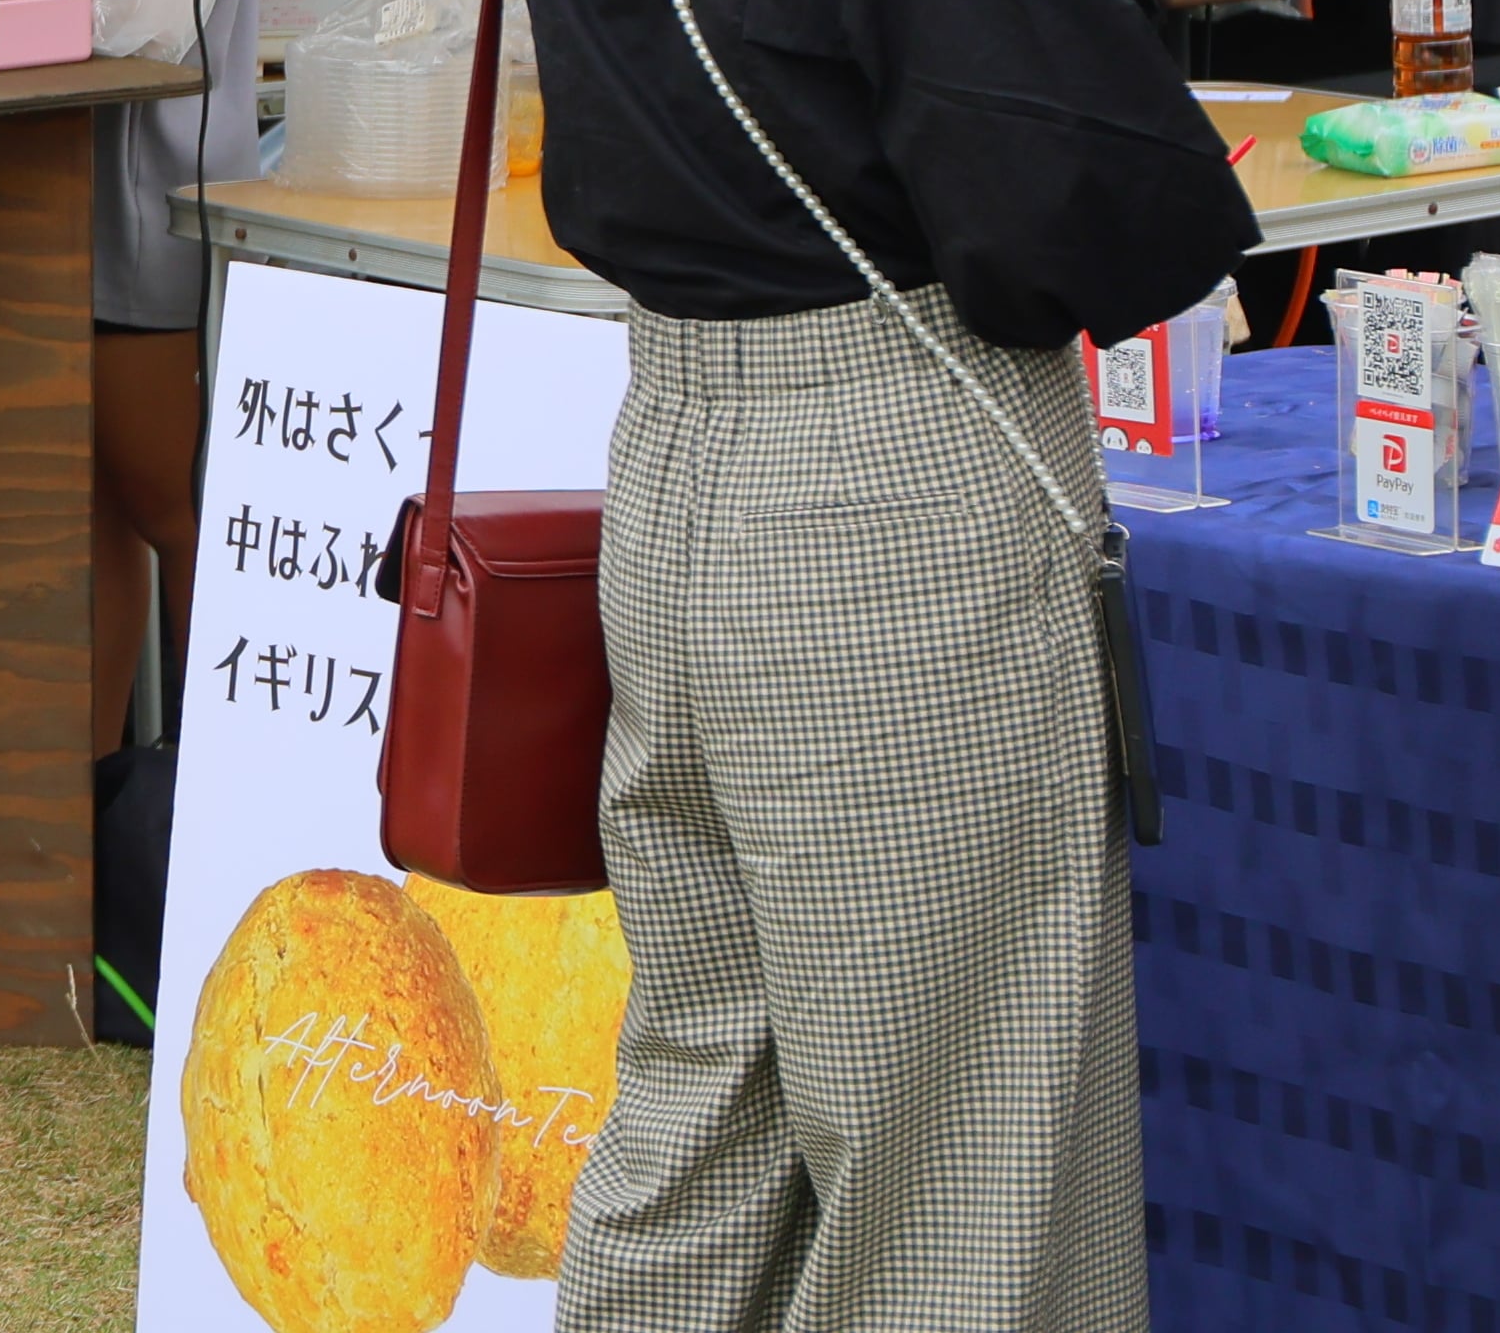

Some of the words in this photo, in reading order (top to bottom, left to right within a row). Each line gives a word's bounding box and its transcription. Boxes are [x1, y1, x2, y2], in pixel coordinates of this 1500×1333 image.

[1376, 474, 1415, 495] PayPay
[212, 635, 384, 736] イギリス
[263, 1011, 533, 1127] Afternoon
